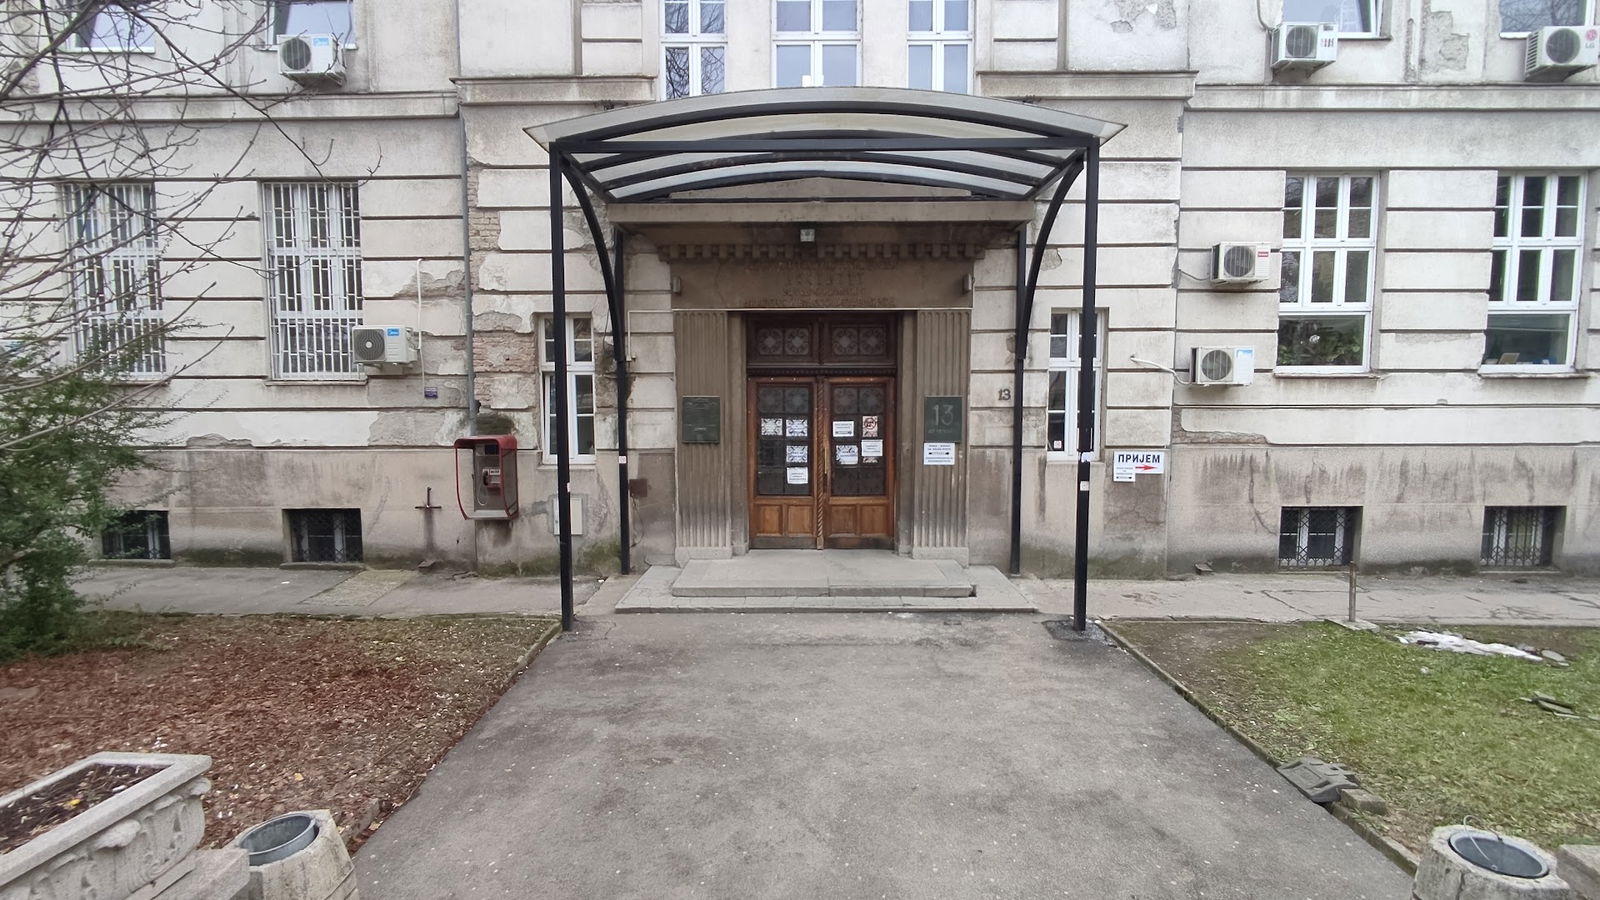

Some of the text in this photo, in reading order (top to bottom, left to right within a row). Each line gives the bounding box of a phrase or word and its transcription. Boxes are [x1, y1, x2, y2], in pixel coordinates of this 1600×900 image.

[998, 388, 1011, 401] 13
[931, 404, 954, 426] 13
[1118, 454, 1161, 463] ПРИЈЕМ
